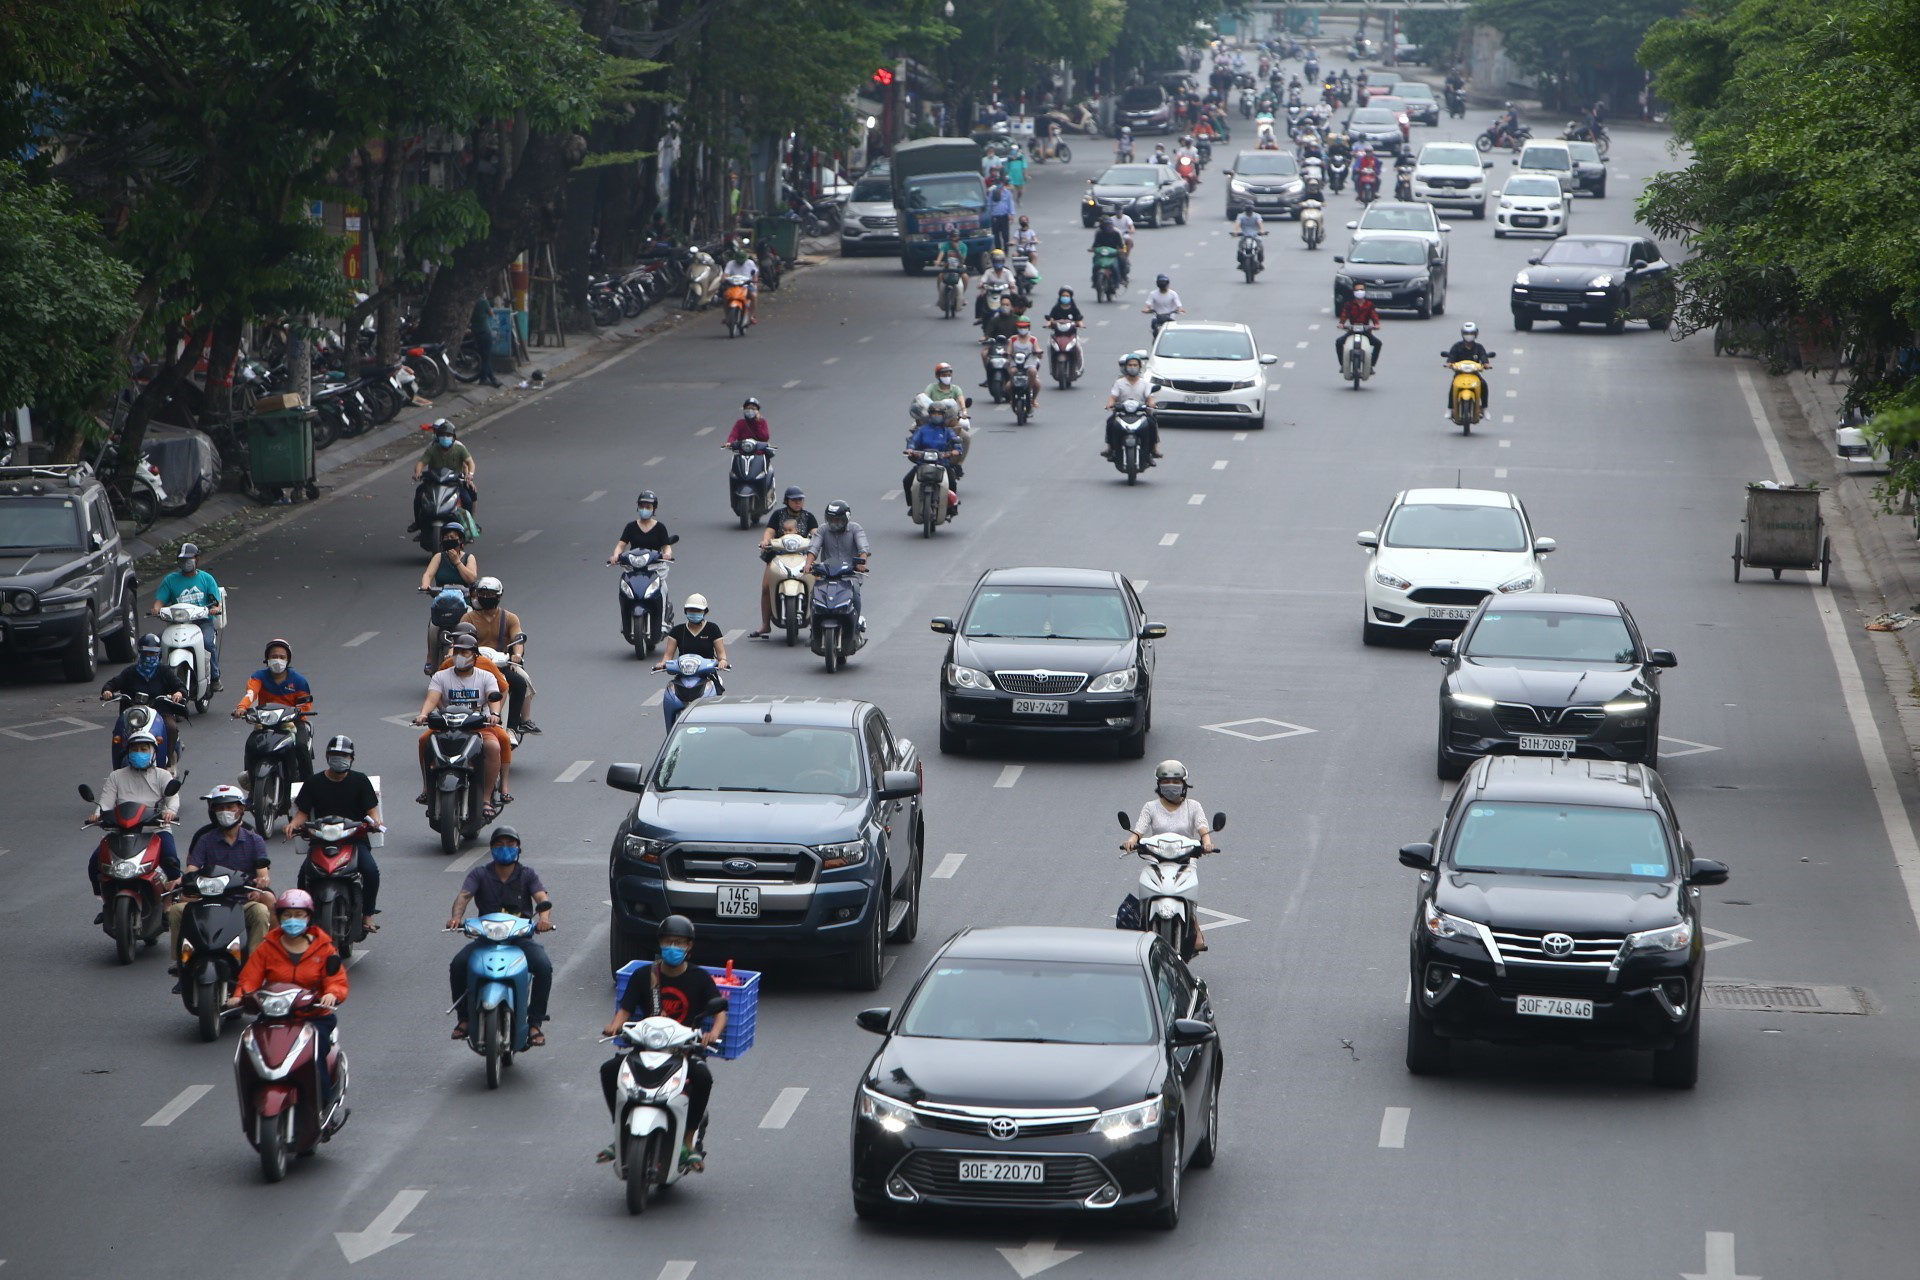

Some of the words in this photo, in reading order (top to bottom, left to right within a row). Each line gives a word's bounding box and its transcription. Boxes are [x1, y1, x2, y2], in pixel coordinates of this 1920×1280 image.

[452, 691, 476, 699] FOLLOW
[1016, 701, 1065, 714] 29V-7427
[1521, 738, 1574, 751] 51H-709.67
[728, 888, 750, 901] 14C
[720, 902, 758, 914] 147.59
[1518, 998, 1592, 1017] 30F-748.46
[961, 1163, 1042, 1181] 30E-220.70
